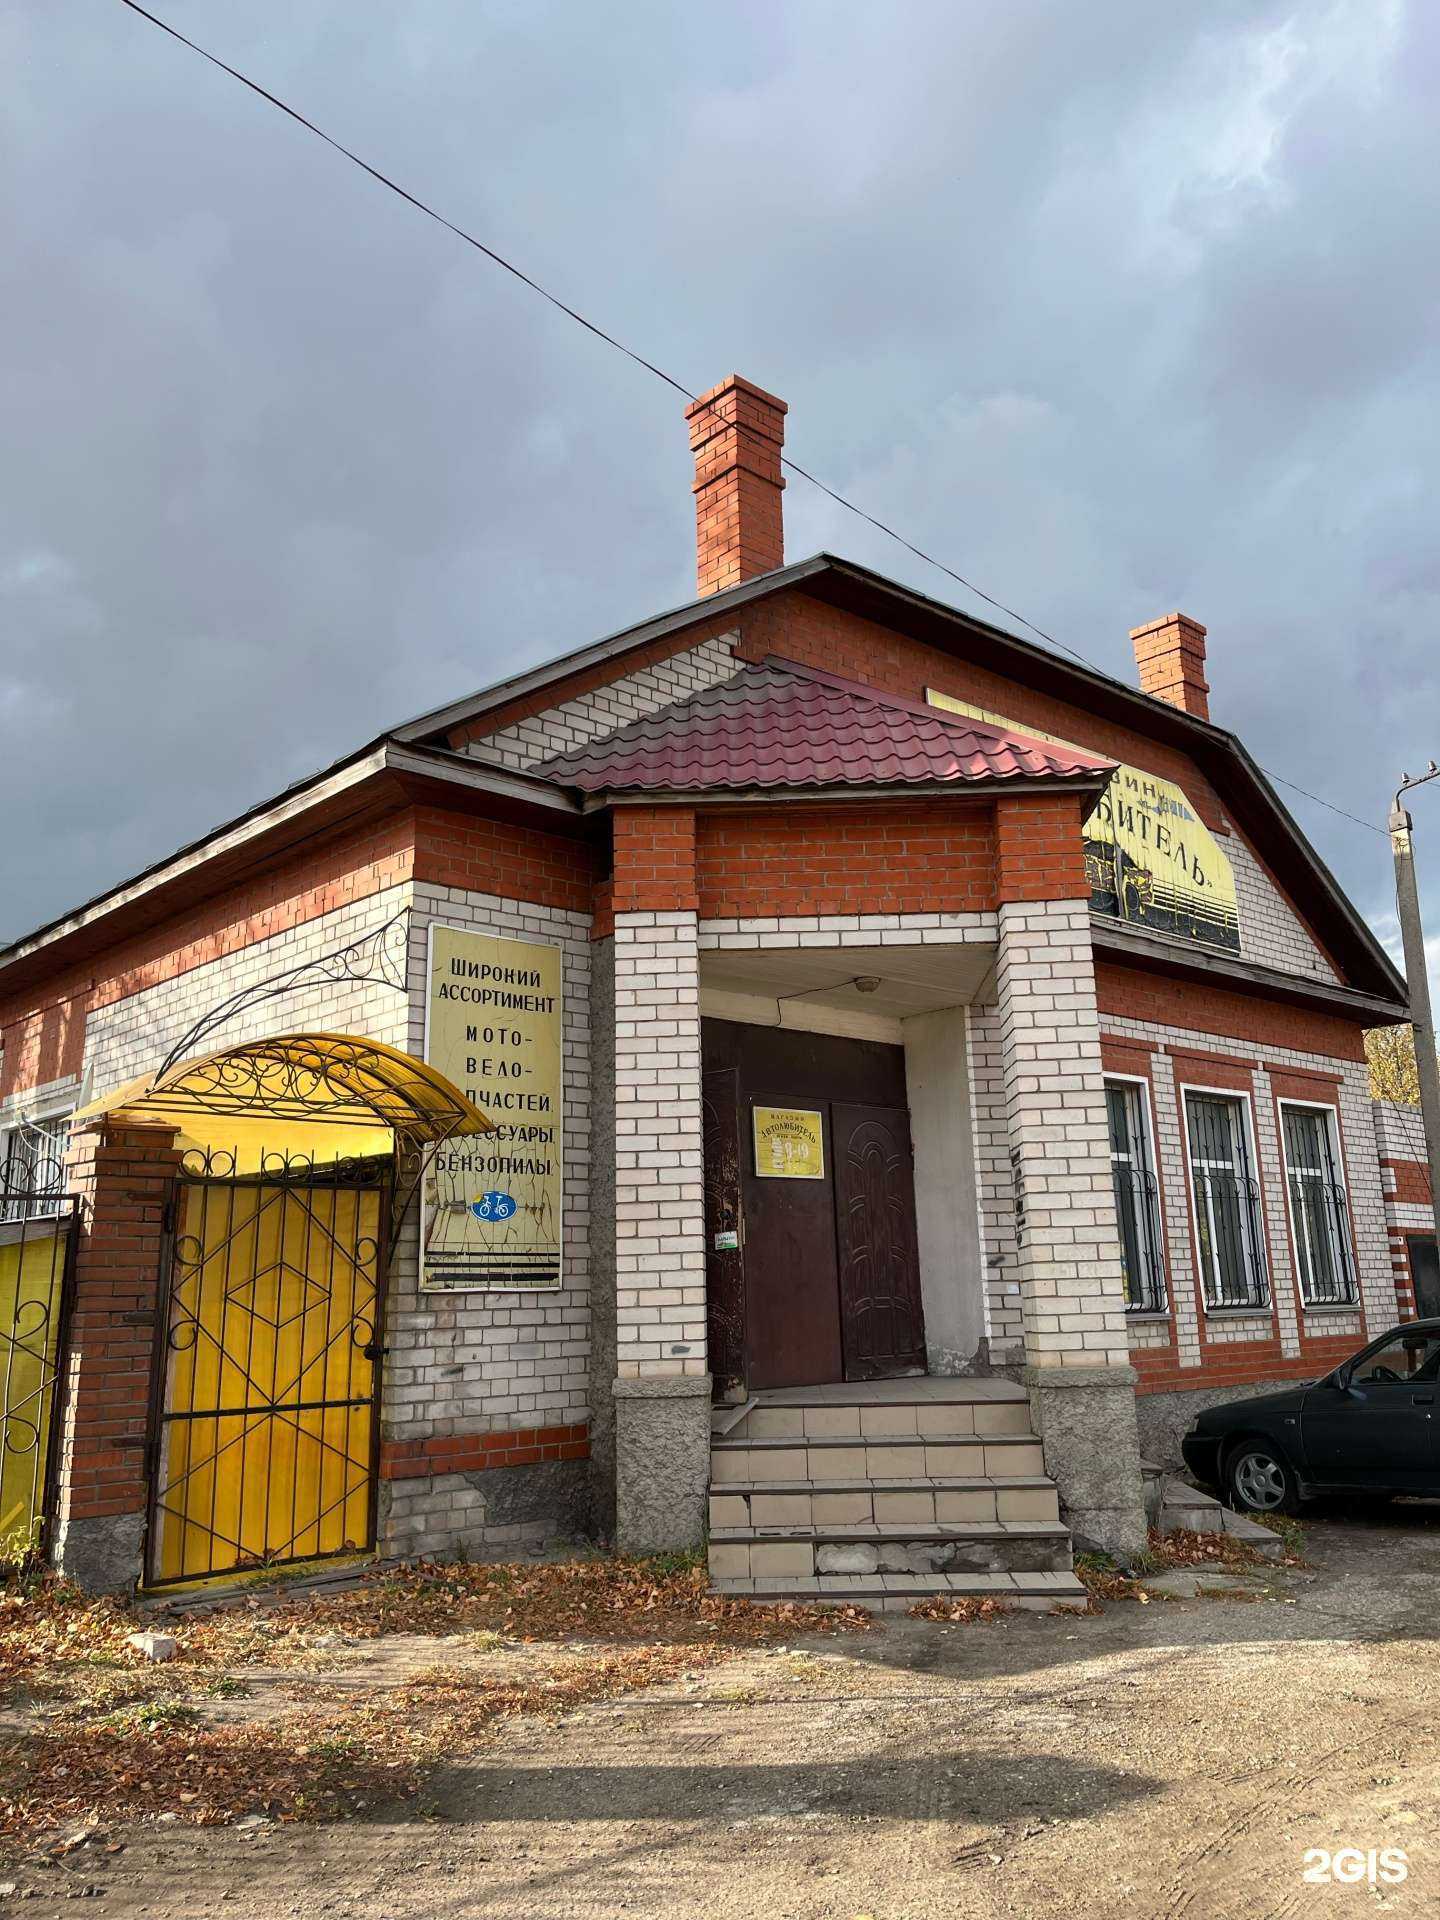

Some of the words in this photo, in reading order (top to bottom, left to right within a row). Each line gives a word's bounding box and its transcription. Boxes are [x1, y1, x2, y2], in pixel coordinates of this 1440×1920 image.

[451, 957, 541, 988] ШИРОКИЙ
[439, 982, 556, 1013] АССОРТИМЕНТ
[466, 1025, 533, 1047] МОТО-
[466, 1057, 533, 1078] ВЕЛО-
[761, 1121, 816, 1144] АВТОЛЮБИТЕЛЬ
